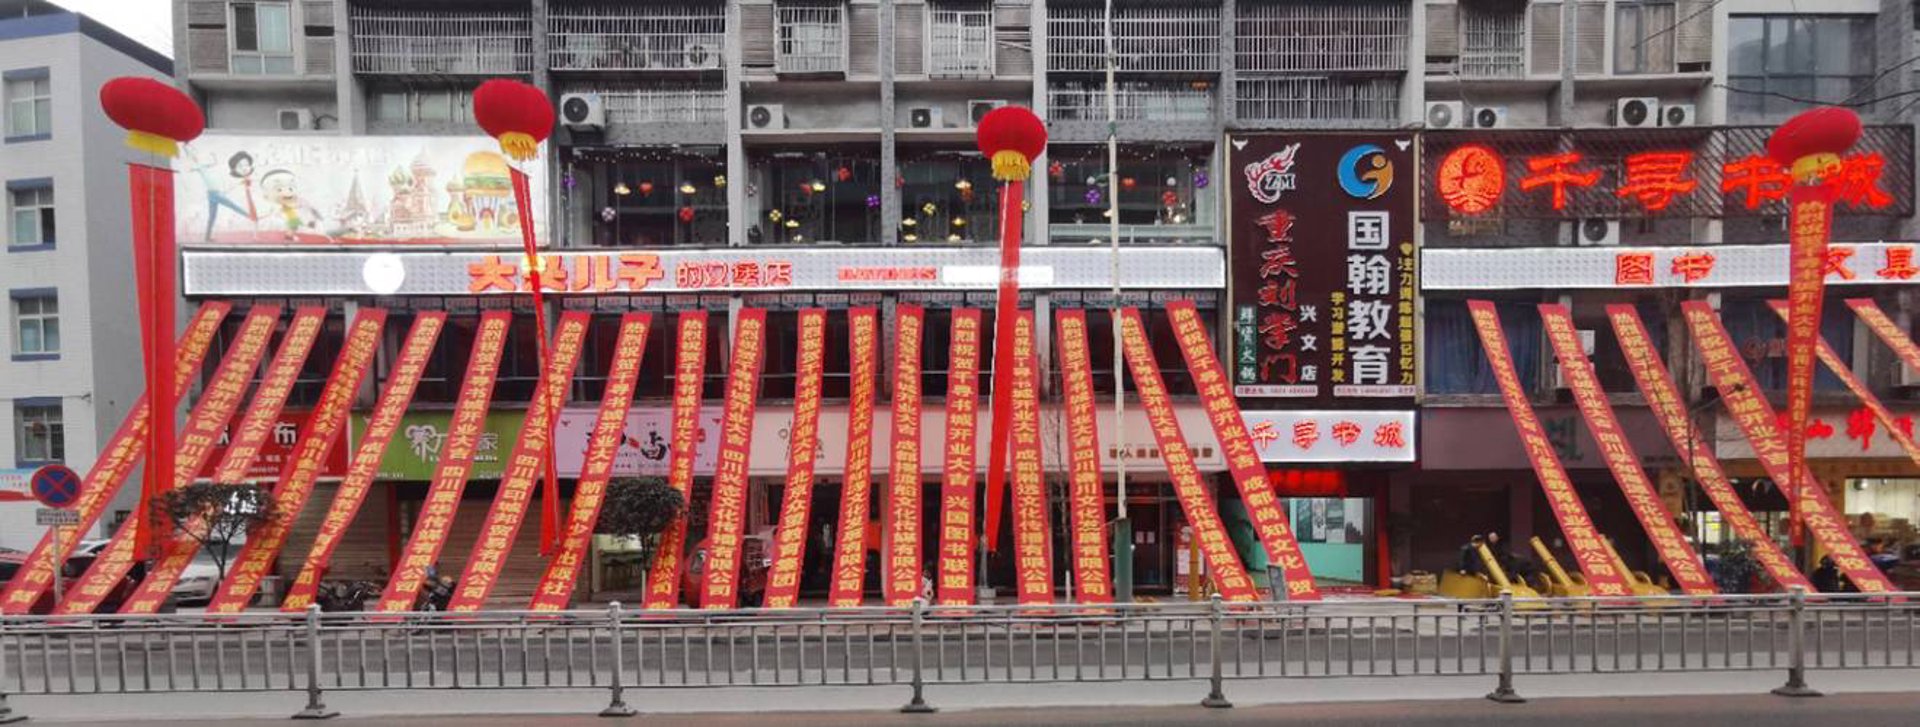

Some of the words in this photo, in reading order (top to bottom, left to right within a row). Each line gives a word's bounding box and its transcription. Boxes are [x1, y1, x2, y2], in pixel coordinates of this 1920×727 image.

[1519, 151, 1893, 210] 千寻书城
[676, 262, 793, 288] 的汉堡店
[1615, 252, 1716, 284] 图书
[1826, 247, 1919, 282] 文具
[1347, 210, 1391, 385] 国翰教育
[1300, 305, 1317, 381] 兴文店
[1250, 418, 1405, 450] 千寻书城
